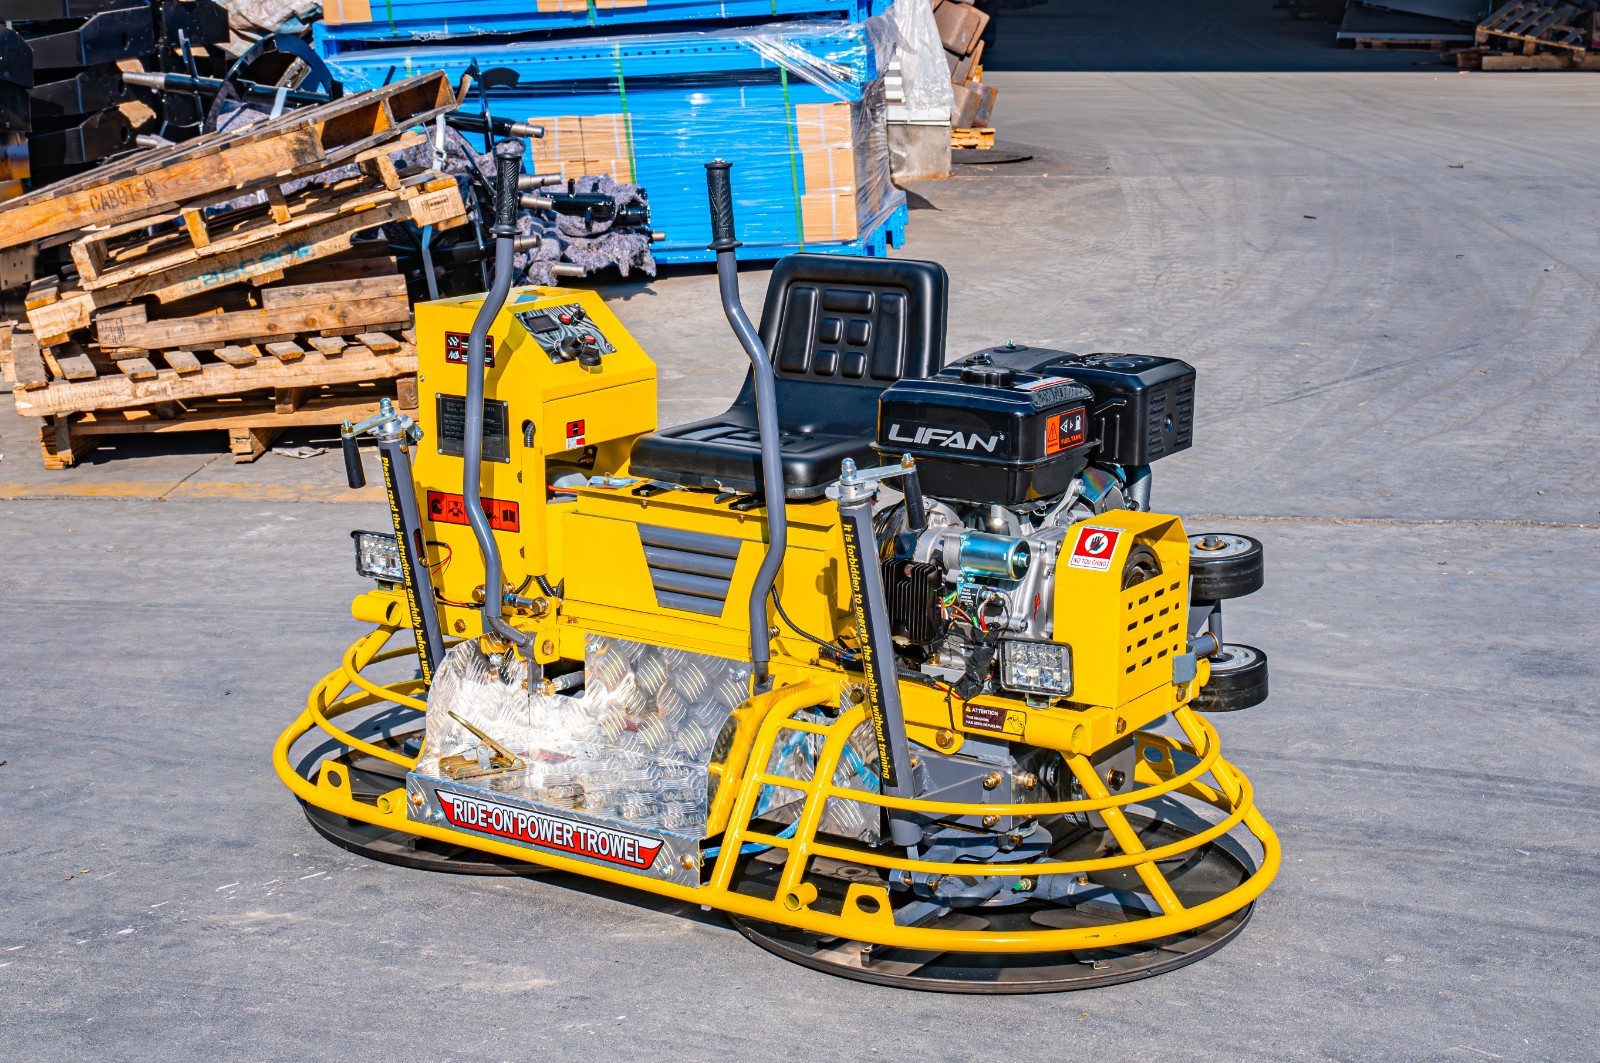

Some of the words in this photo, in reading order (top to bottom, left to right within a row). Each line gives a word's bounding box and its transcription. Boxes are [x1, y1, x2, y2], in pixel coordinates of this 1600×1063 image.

[888, 423, 999, 453] LIFAN
[381, 456, 390, 488] Please
[388, 490, 399, 511] read
[393, 512, 401, 530] the
[843, 524, 853, 532] It
[845, 534, 854, 543] is
[396, 532, 412, 587] instructions
[847, 544, 861, 592] forbidden
[407, 588, 422, 628] carefully
[854, 593, 863, 604] to
[856, 606, 870, 644] operate
[415, 629, 427, 659] before
[863, 645, 872, 661] the
[421, 660, 432, 685] using
[866, 662, 879, 704] machine
[872, 705, 886, 742] without
[971, 707, 999, 716] ATTENTION
[878, 743, 891, 780] training
[453, 799, 514, 835] RIDE-ON
[517, 812, 575, 848] POWER
[577, 826, 645, 864] TROWEL
